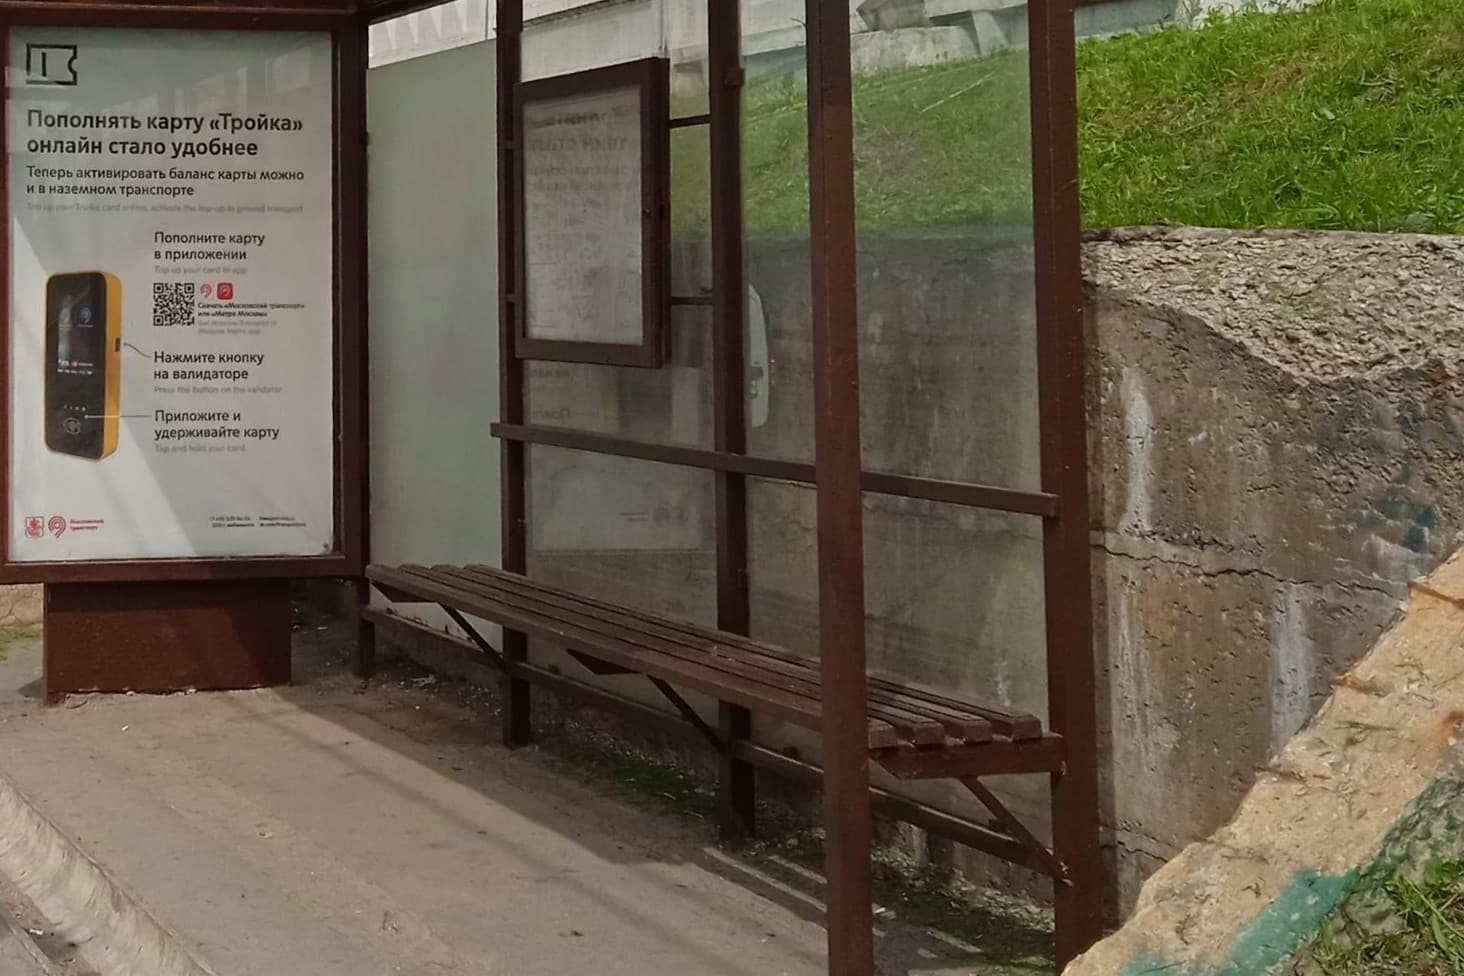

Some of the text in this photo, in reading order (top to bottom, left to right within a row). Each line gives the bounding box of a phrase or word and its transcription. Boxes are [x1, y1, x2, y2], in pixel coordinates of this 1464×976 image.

[27, 109, 302, 134] Пополнять карту «Тройка»
[27, 136, 258, 159] онлайн стало удобнее
[26, 165, 304, 182] Теперь активировать баланс карты можно
[26, 184, 194, 198] и в наземном транспорте
[154, 231, 265, 246] Пополните карту
[154, 250, 247, 262] в приложении
[154, 351, 264, 366] Нажмите кнопку
[154, 370, 249, 382] на валидаторе
[155, 409, 241, 424] Приложите и
[154, 426, 280, 441] удерживайте карту
